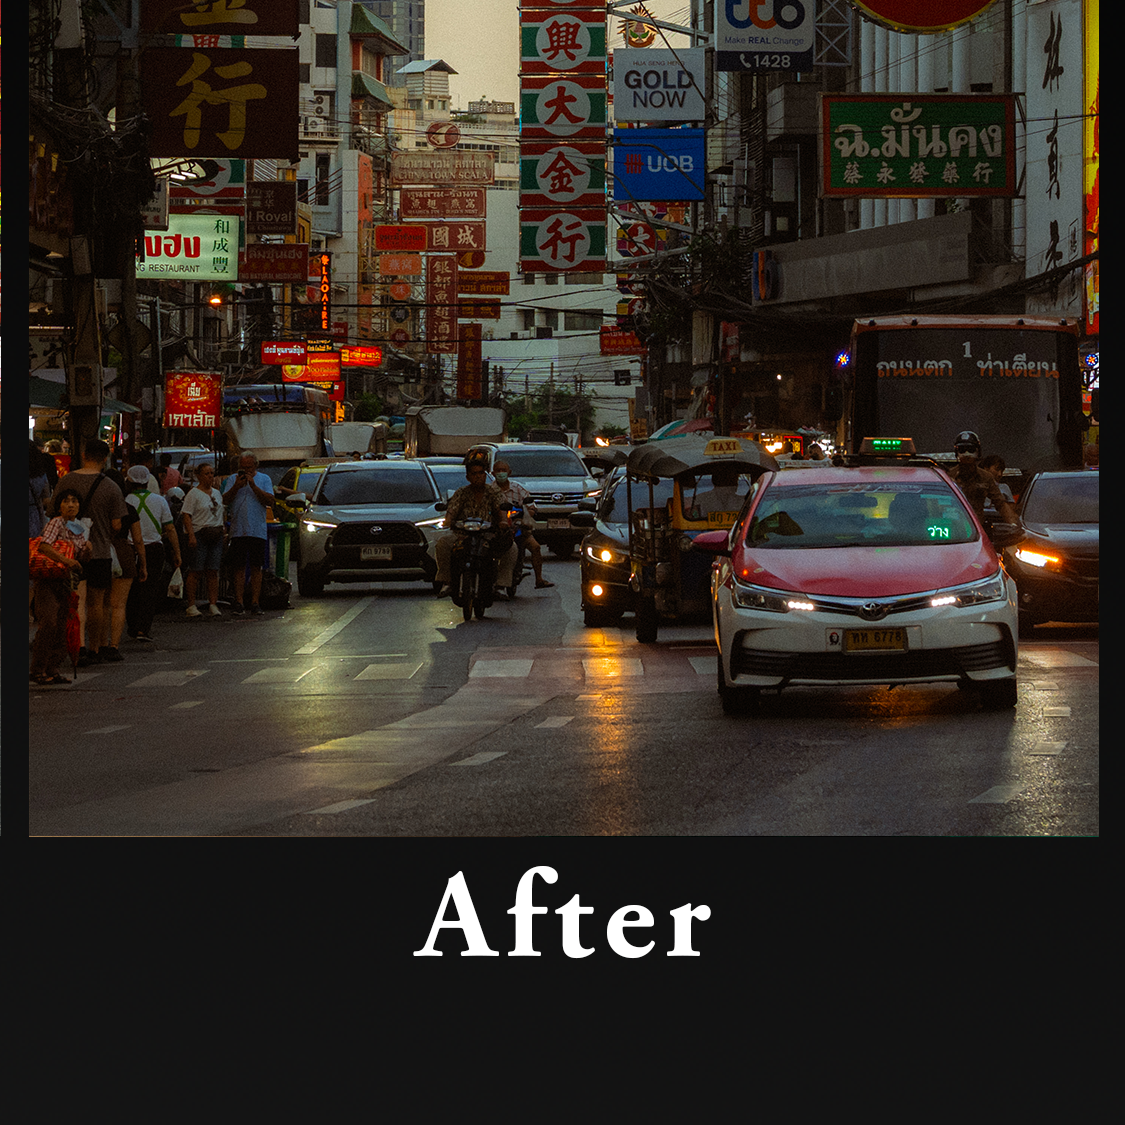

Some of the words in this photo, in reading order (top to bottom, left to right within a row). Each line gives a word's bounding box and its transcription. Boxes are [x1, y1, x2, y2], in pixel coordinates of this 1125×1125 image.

[748, 36, 771, 45] REAL
[753, 54, 792, 68] 1428
[624, 69, 693, 89] GOLD
[632, 89, 686, 108] NOW
[646, 154, 694, 173] UOB
[430, 171, 455, 180] TOWN
[458, 171, 488, 180] SCALA
[257, 210, 293, 223] Royal
[144, 234, 200, 258] งฮง
[148, 265, 200, 273] RESTAURANT
[962, 341, 973, 358] 1
[976, 352, 1061, 380] ท่าเตียน
[168, 408, 215, 427] เกาลัด
[711, 441, 737, 451] TAXI
[927, 526, 950, 539] ว่าง
[875, 631, 903, 643] 6778
